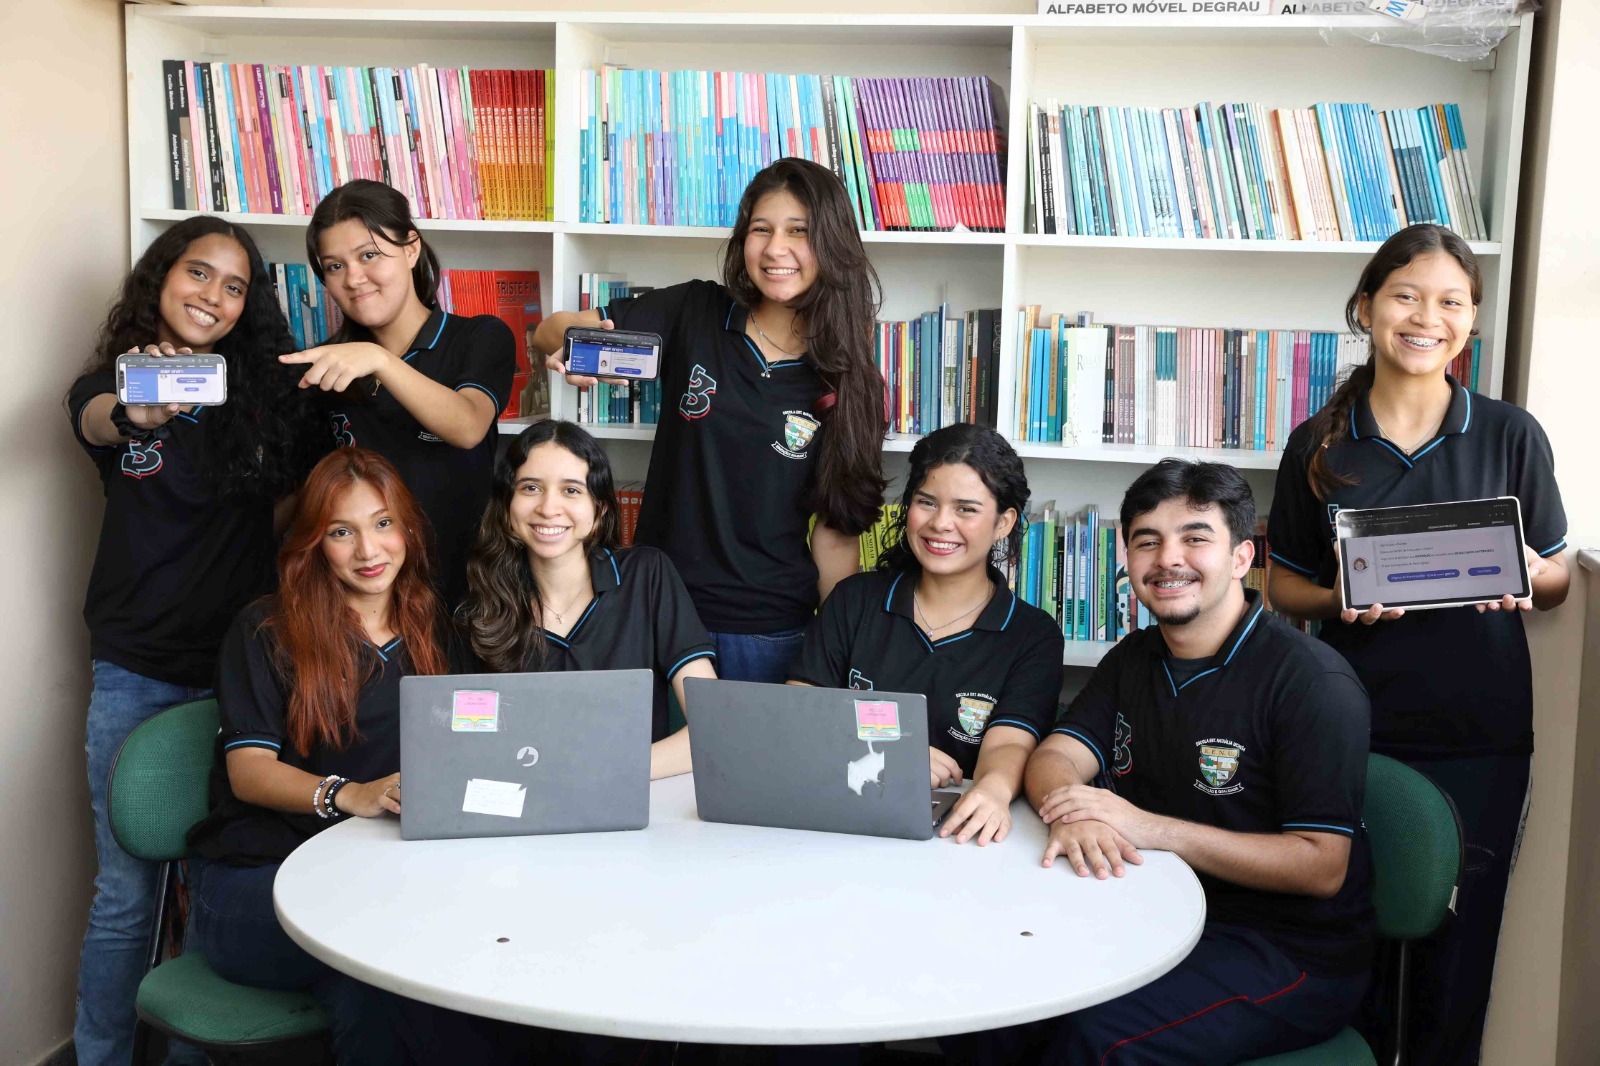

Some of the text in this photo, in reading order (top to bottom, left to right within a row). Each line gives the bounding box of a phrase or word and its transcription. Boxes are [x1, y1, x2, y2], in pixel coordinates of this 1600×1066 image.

[1047, 0, 1260, 14] ALFABETO MÓVEL DEGRAU
[496, 281, 523, 295] TRISTE
[680, 364, 716, 421] 3
